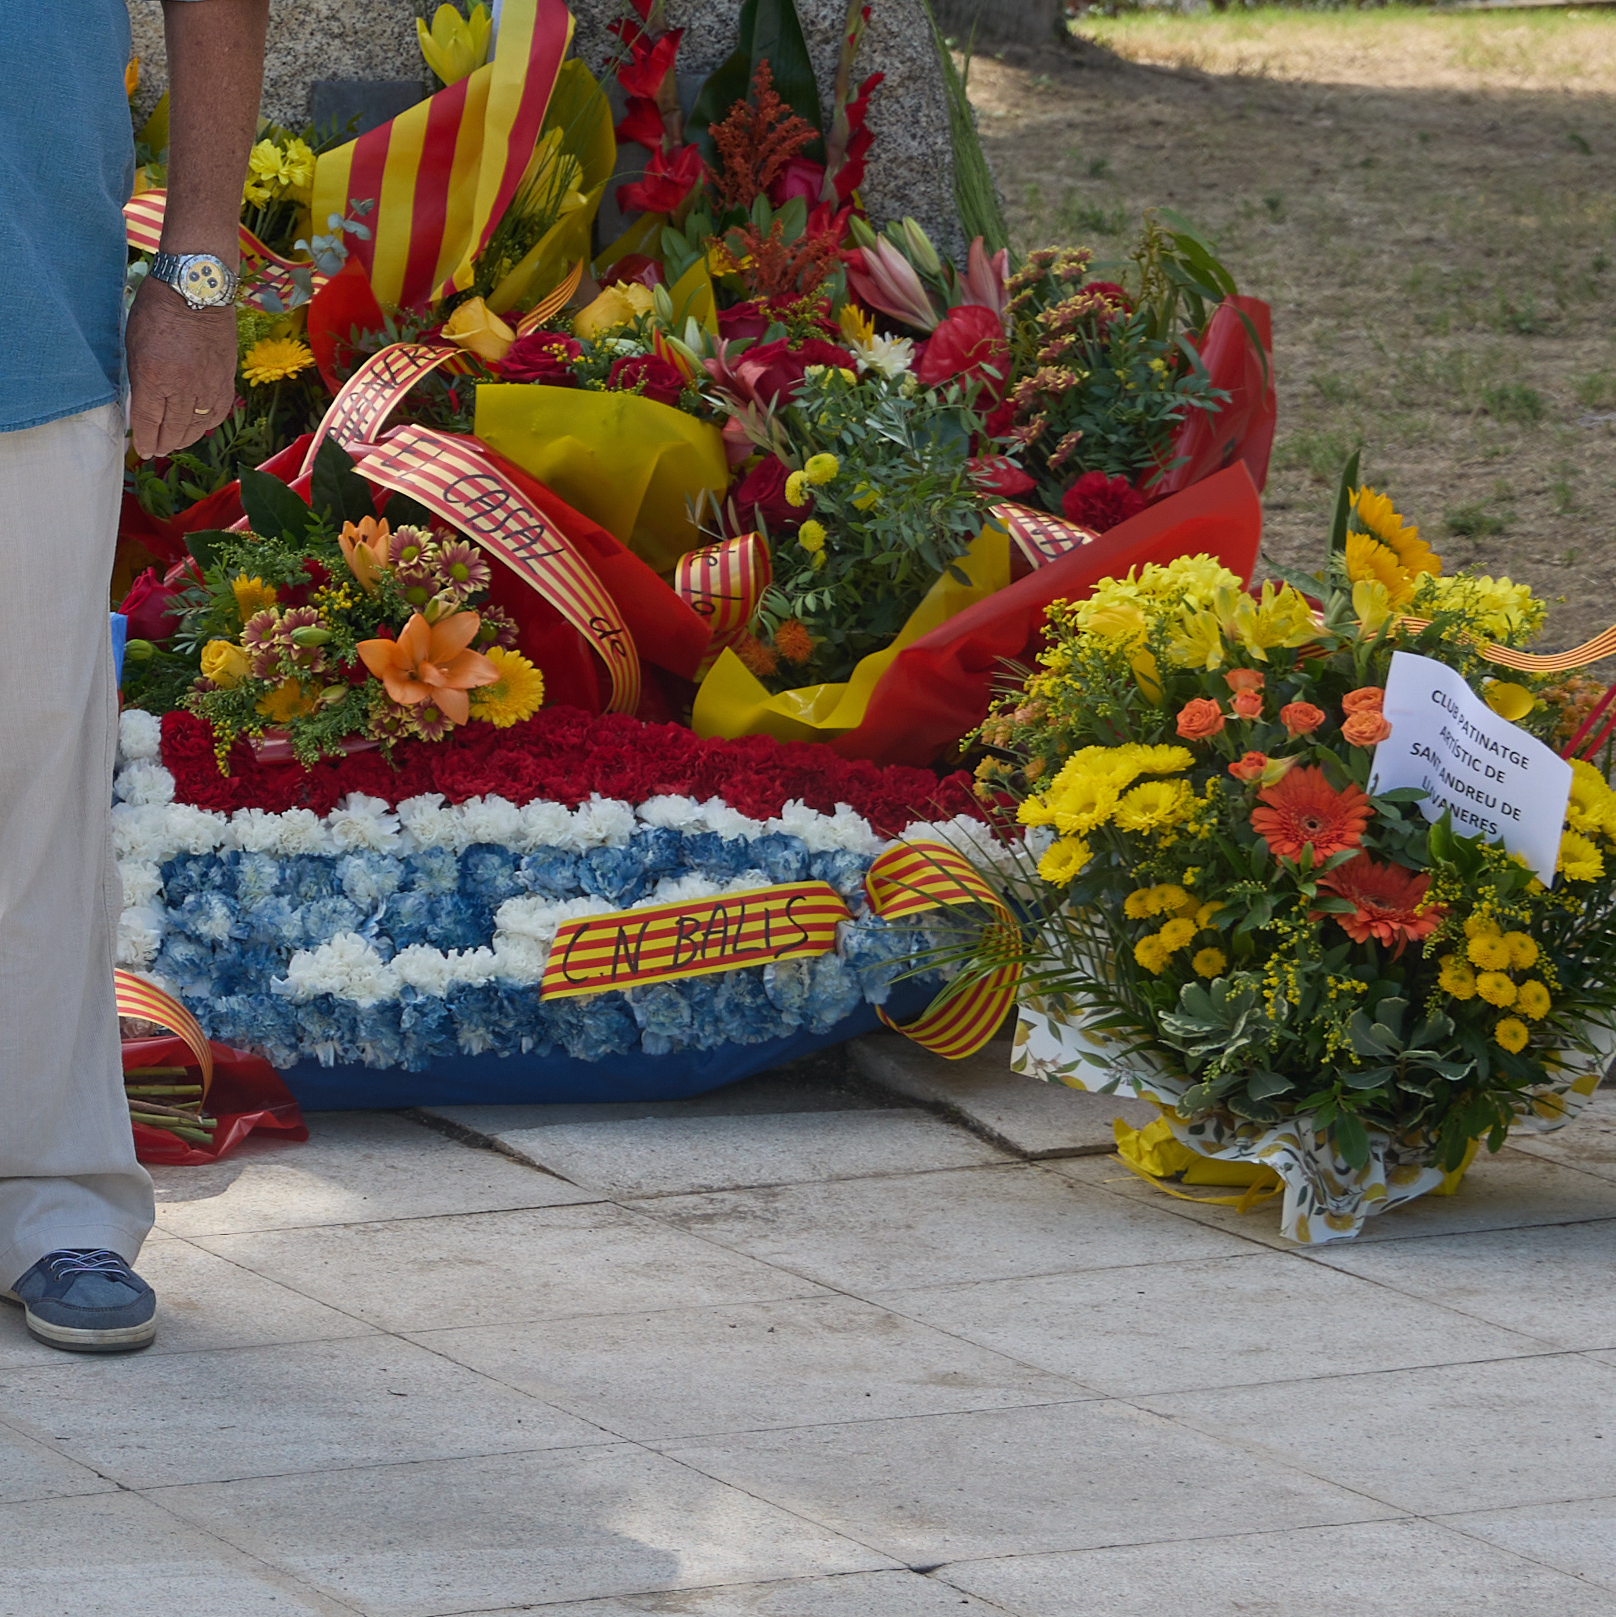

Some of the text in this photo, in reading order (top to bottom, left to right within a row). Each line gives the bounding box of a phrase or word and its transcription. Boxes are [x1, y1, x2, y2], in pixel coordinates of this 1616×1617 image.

[380, 436, 446, 485] EL
[443, 473, 565, 575] CASAL
[1431, 690, 1530, 770] CLUB PATINATGE
[1439, 726, 1506, 784] ARTÍSTIC DE
[1410, 742, 1522, 821] SANT ANDREU DE
